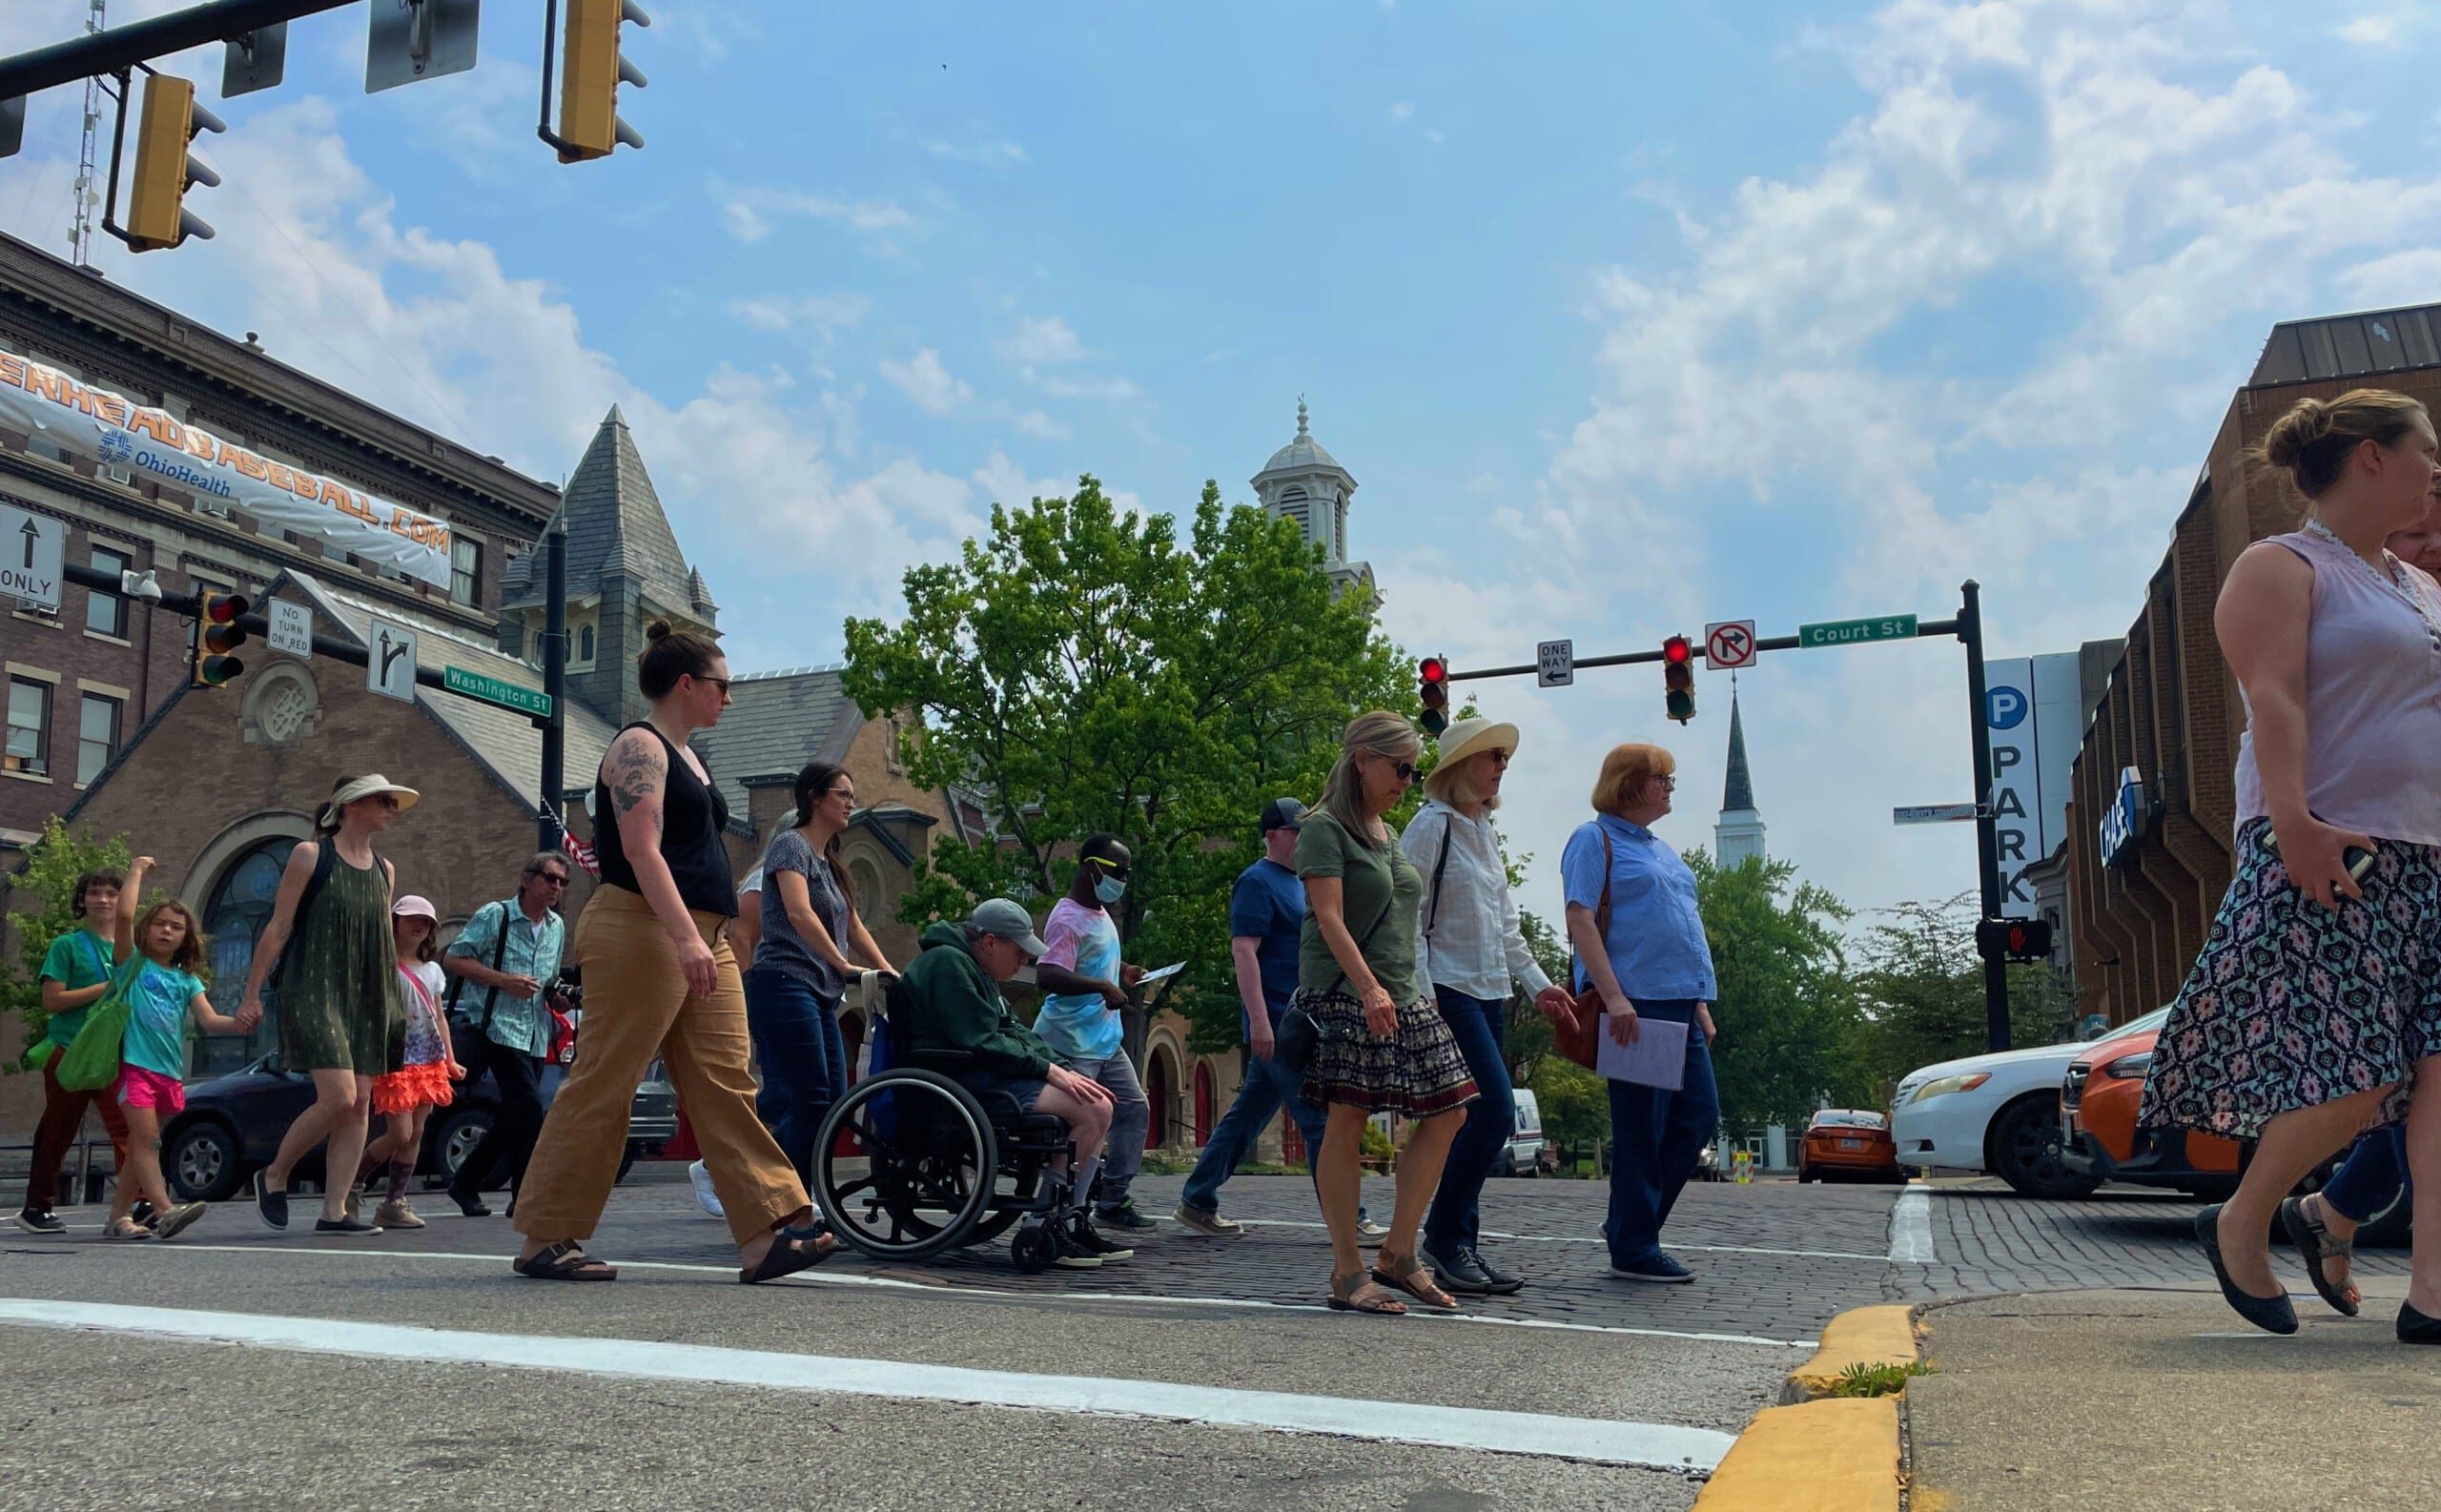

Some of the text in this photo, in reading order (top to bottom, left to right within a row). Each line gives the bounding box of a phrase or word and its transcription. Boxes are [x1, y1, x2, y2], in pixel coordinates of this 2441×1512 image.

[135, 451, 230, 497] OhioHealth
[1, 569, 51, 596] ONLY
[282, 607, 298, 620] NO
[277, 620, 303, 636] TURN
[1813, 621, 1904, 643] Court St
[272, 632, 308, 651] ON RED
[1541, 644, 1568, 657] ONE
[1541, 656, 1568, 669] WAY
[450, 669, 546, 710] Washington St
[1992, 694, 2019, 723] P
[1992, 746, 2031, 903] PARK
[2100, 787, 2128, 868] CHASE
